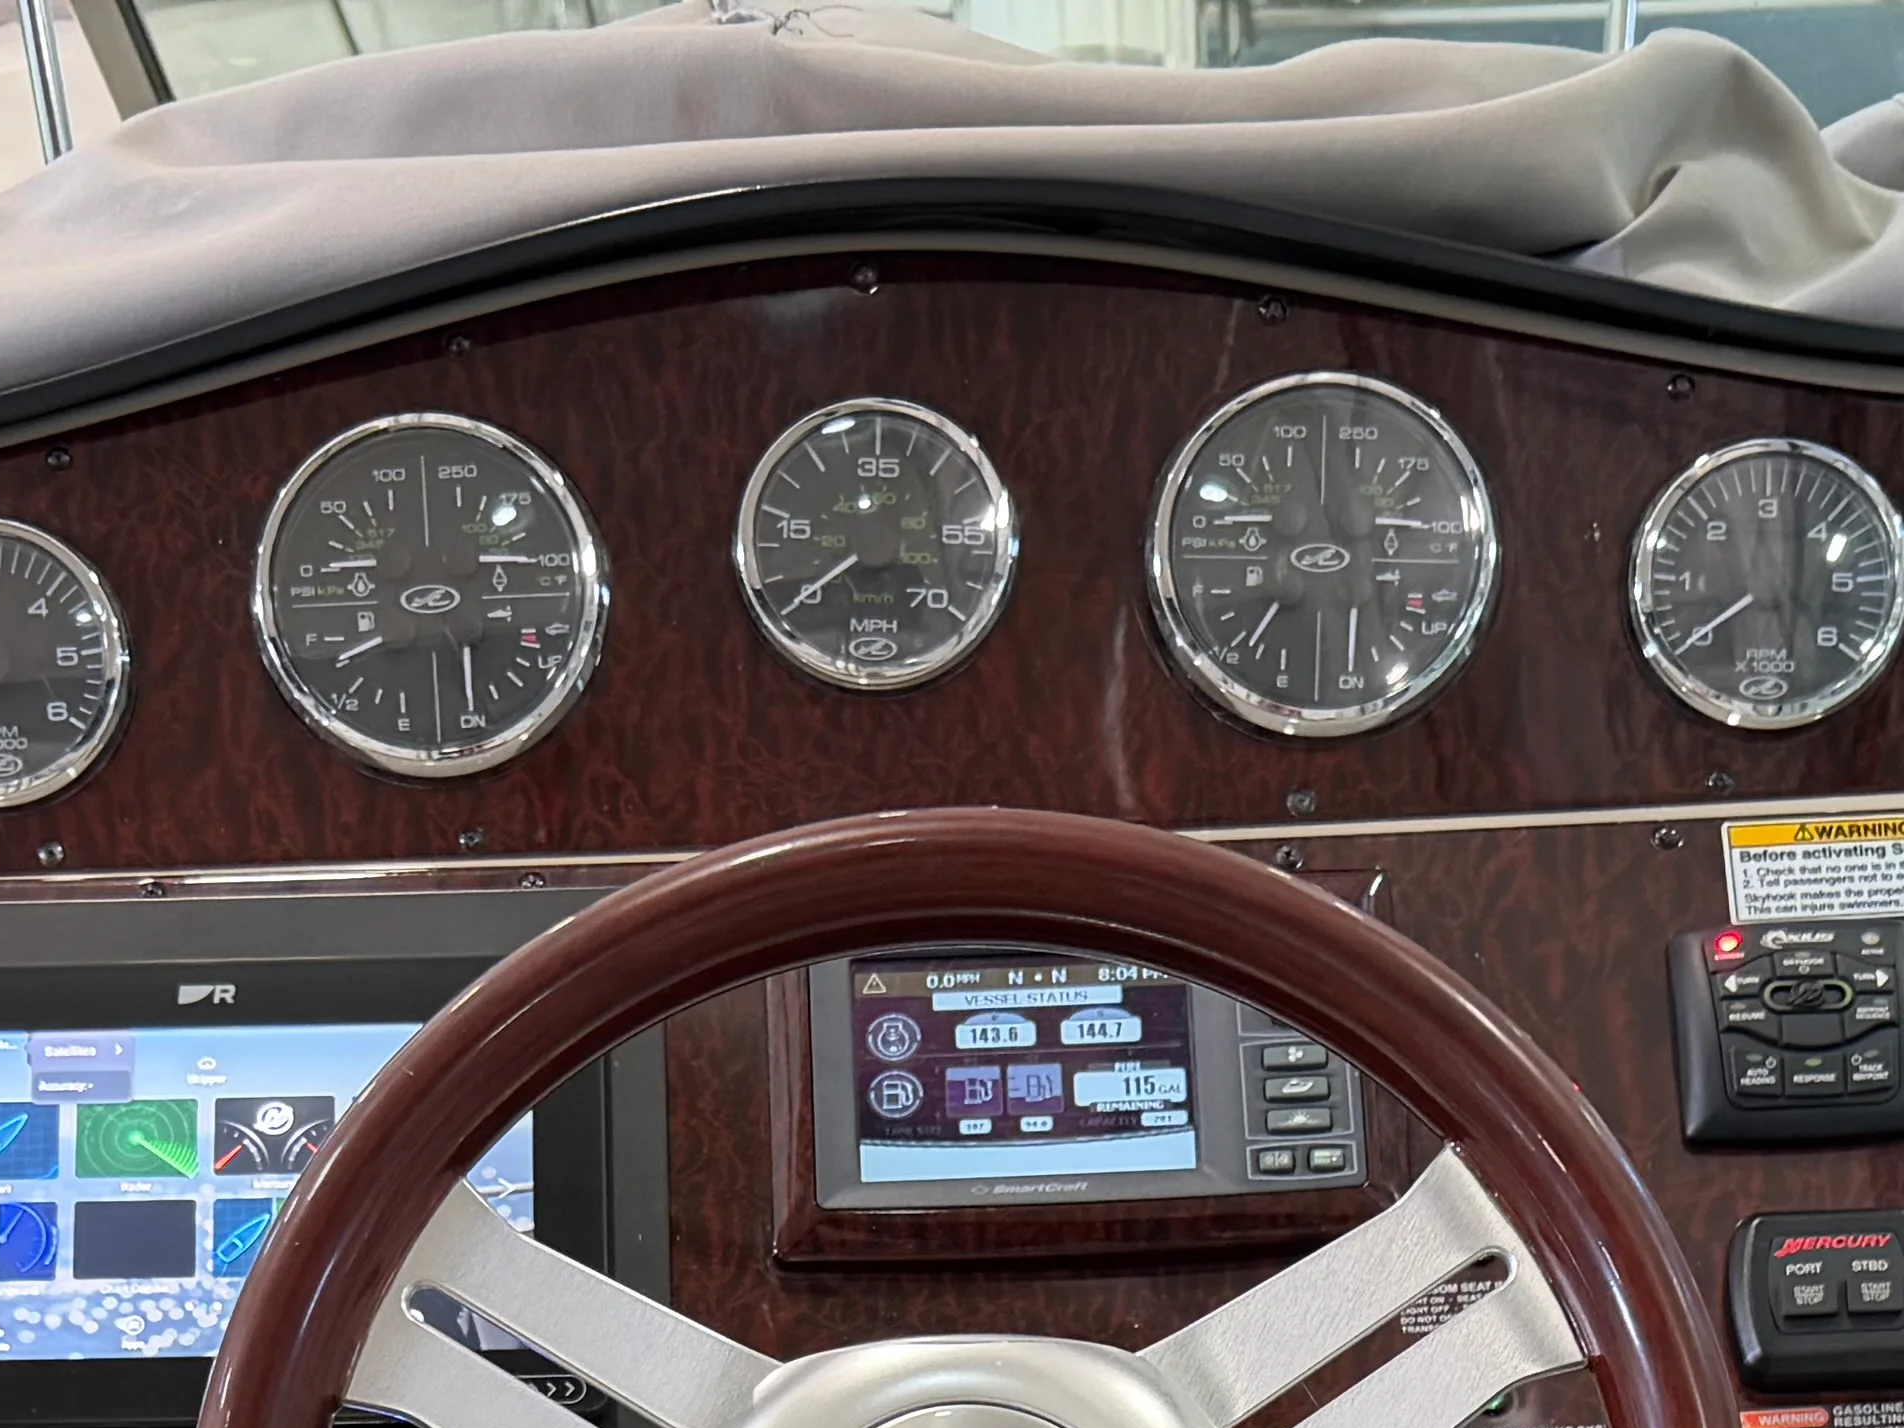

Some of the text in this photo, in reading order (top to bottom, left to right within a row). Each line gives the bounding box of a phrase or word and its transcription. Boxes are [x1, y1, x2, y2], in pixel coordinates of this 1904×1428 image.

[1273, 426, 1306, 438] 100
[1339, 426, 1377, 440] 250
[1219, 454, 1245, 466] 50
[1398, 458, 1429, 470] 175
[372, 468, 405, 481] 100
[438, 465, 477, 479] 250
[857, 458, 900, 478] 35
[320, 501, 346, 515] 50
[1758, 500, 1776, 518] 3
[777, 520, 811, 539] 15
[942, 525, 985, 544] 55
[1431, 521, 1463, 534] 100
[1706, 521, 1726, 540] 2
[1808, 522, 1828, 540] 4
[538, 554, 569, 566] 100
[1679, 571, 1691, 591] 1
[1832, 572, 1853, 592] 5
[906, 589, 948, 608] 70
[27, 597, 49, 618] 4
[850, 619, 896, 632] MPH
[1422, 621, 1448, 634] UP
[1817, 626, 1838, 646] 6
[56, 647, 78, 666] 5
[1746, 650, 1787, 660] RPM
[1735, 660, 1794, 672] X 1000
[1277, 676, 1288, 688] E
[1339, 677, 1364, 689] DN
[46, 702, 68, 721] 6
[398, 719, 410, 731] E
[461, 715, 486, 728] DN
[1740, 849, 1797, 863] Before
[1802, 843, 1886, 860] activating
[1745, 890, 1796, 905] Skyhook
[1801, 888, 1838, 900] makes
[1845, 887, 1864, 897] the
[1746, 899, 1904, 916] This can injure swimmers.
[926, 972, 980, 990] 0.0 MPH
[1009, 967, 1067, 985] N N
[1853, 973, 1875, 981] TURN
[965, 990, 1088, 1006] VESSEL STATUS
[1729, 1012, 1765, 1021] RESUME
[970, 1027, 1018, 1044] 143.6
[1077, 1022, 1123, 1039] 144.7
[1123, 1075, 1182, 1096] 115 GAL
[1793, 1073, 1837, 1083] RESPONSE
[1096, 1100, 1165, 1112] REMAINING
[993, 1181, 1089, 1194] SmartCraft
[1774, 1233, 1894, 1258] MERCURY
[1786, 1262, 1822, 1276] PORT
[1852, 1260, 1888, 1272] STBD
[1758, 1411, 1824, 1426] WARNING
[1833, 1402, 1904, 1416] GASOLINE
